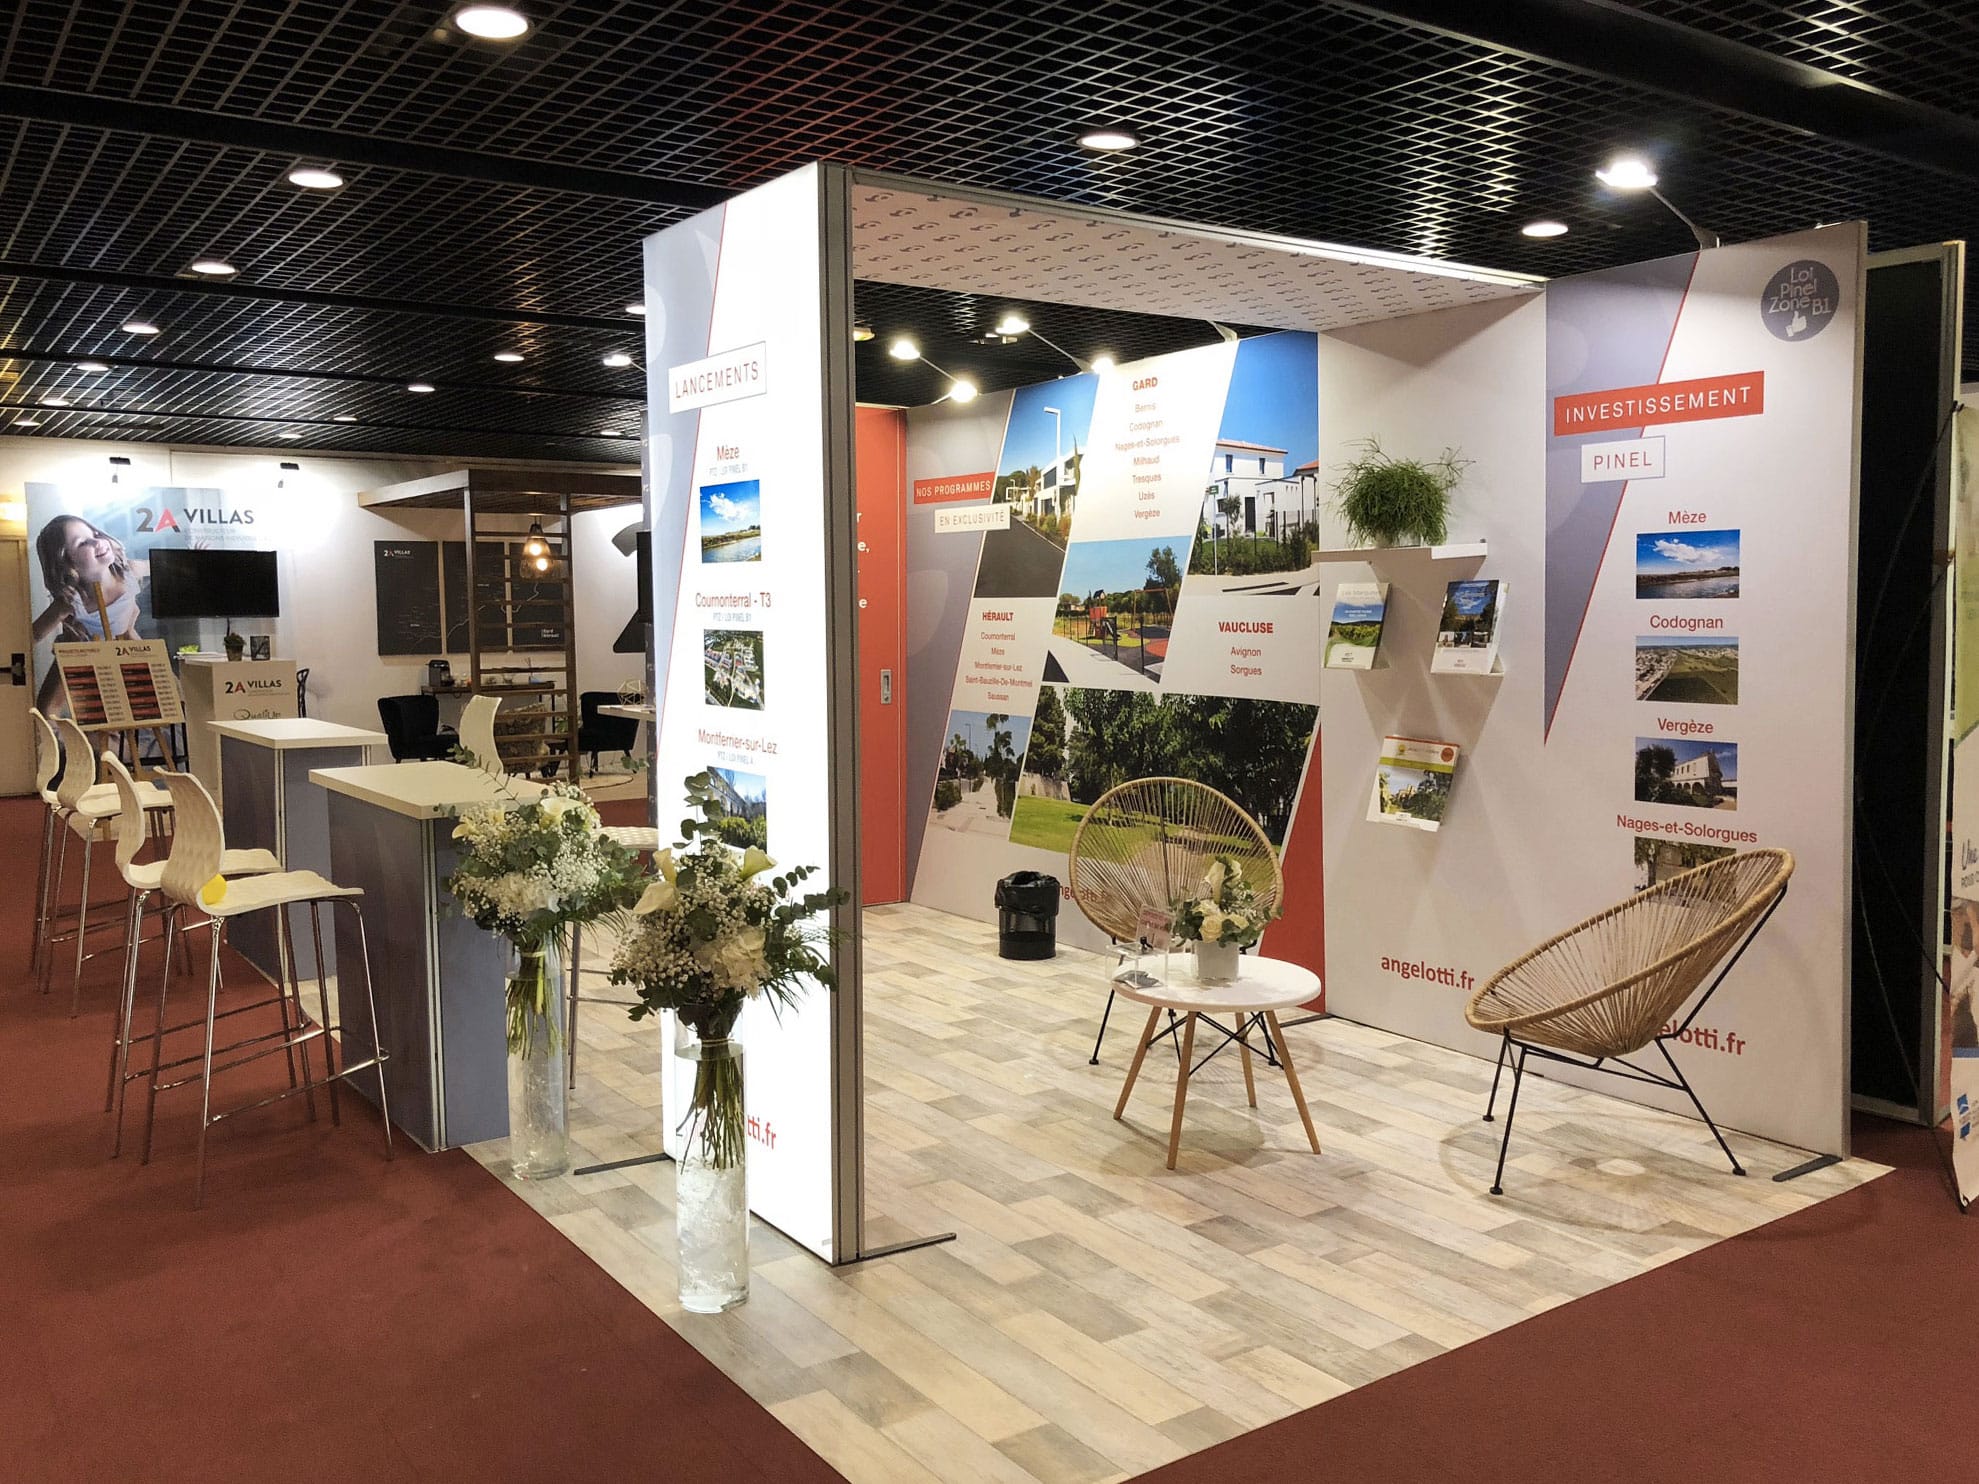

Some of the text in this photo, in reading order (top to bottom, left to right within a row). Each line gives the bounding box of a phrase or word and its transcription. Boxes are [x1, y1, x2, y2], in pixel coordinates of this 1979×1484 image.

[1791, 266, 1814, 283] Loi
[1780, 279, 1817, 298] Pinel
[1768, 296, 1831, 315] Zone B1
[675, 361, 759, 399] LANCEMENTS
[1132, 377, 1158, 391] GARD
[1565, 386, 1752, 425] INVESTISSEMENT
[717, 445, 740, 461] Mèze
[1593, 451, 1652, 471] PINEL
[916, 480, 991, 497] NOS PROGRAMMES
[136, 507, 255, 533] 2A VILLAS
[940, 509, 1005, 526] EN EXCLUSIVITÉ
[1668, 510, 1707, 524] Mèze
[760, 591, 771, 608] T3
[982, 609, 1014, 621] HÉRAULT
[1649, 614, 1724, 631] Codognan
[1218, 621, 1274, 634] VAUCLUSE
[129, 645, 151, 653] VILLAS
[1230, 646, 1262, 658] Avignon
[1230, 664, 1263, 677] Sorgues
[225, 681, 246, 694] 2A
[247, 679, 282, 689] VILLAS
[1657, 717, 1714, 735] Vergèze
[1616, 814, 1758, 843] Nages-et-Solorgues
[1381, 956, 1475, 991] angelotti.fr
[1659, 1019, 1746, 1056] elotti.fr
